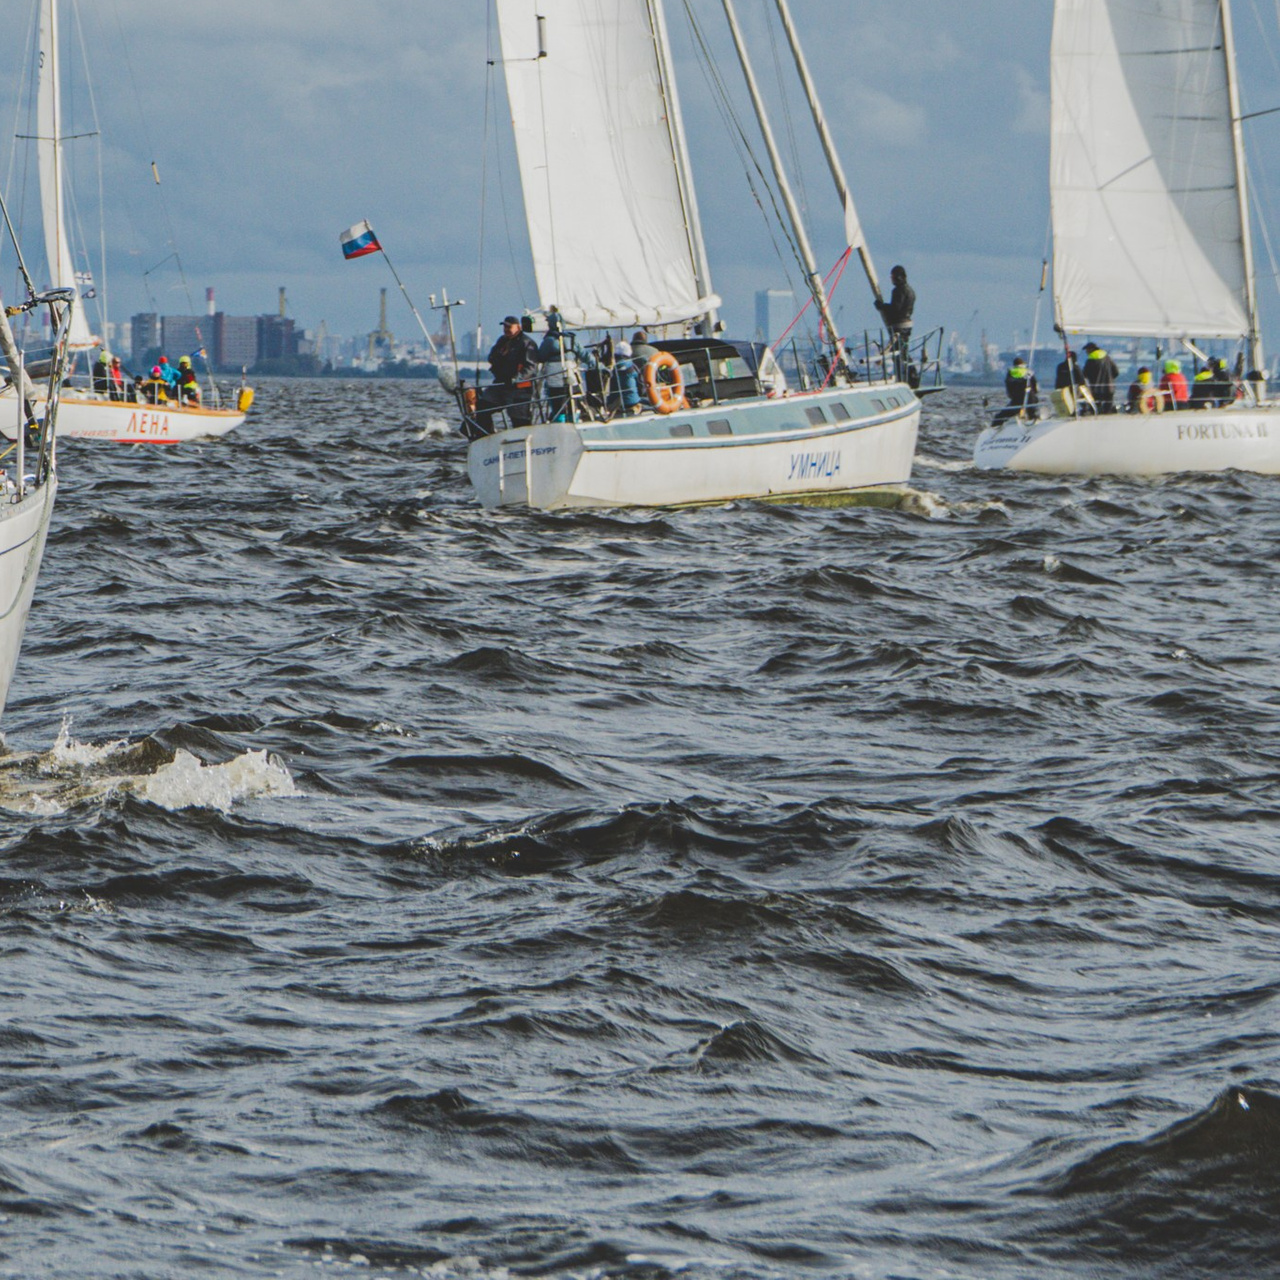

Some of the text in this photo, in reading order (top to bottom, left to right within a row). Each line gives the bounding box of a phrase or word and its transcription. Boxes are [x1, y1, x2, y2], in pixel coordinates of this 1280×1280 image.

[126, 412, 169, 435] ЛЕНА
[1176, 422, 1269, 441] FORTUNA II
[483, 446, 558, 466] САНТ-ПЕТРБУРГ
[788, 450, 841, 482] УМНИЦА
